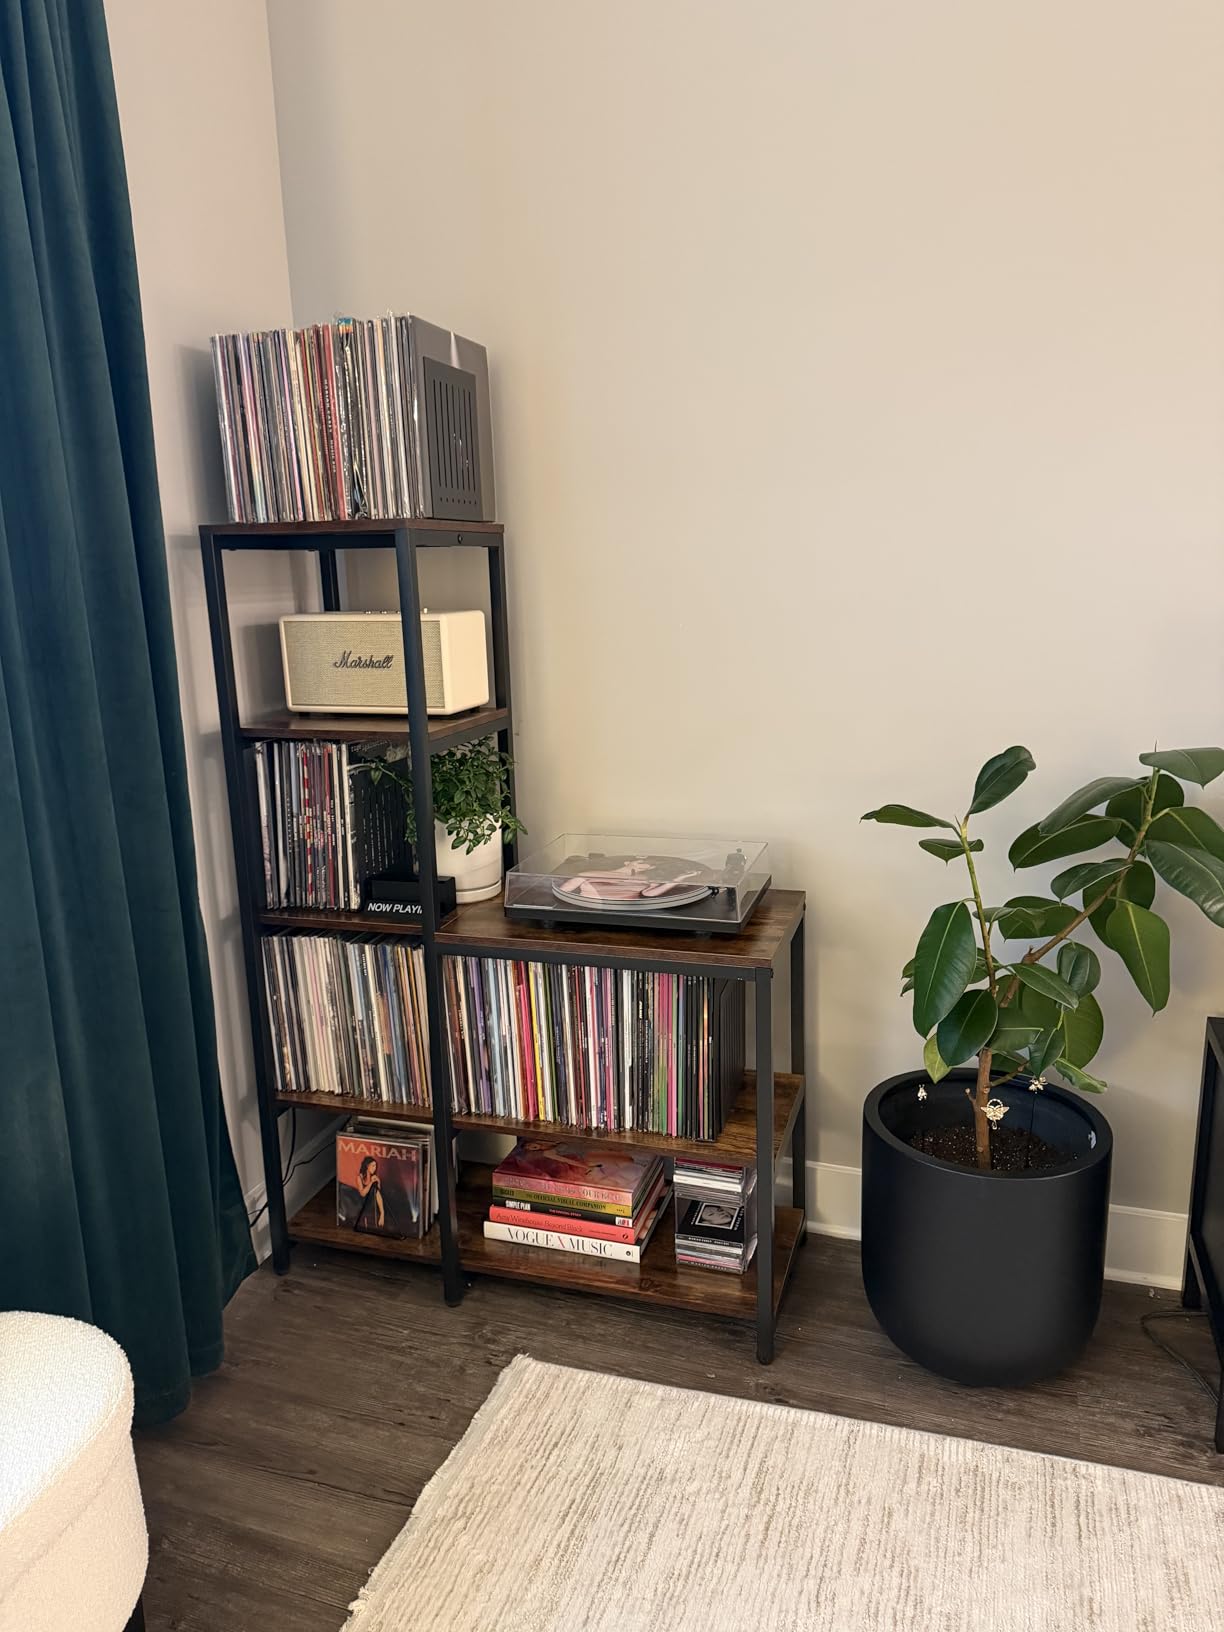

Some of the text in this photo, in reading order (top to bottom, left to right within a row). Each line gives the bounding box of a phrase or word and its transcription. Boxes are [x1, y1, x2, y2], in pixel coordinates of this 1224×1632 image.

[333, 649, 394, 669] Marshall
[367, 902, 422, 914] NOW PLAYI
[339, 1140, 417, 1161] MARIAH
[505, 1199, 531, 1211] SIMPLE PLAN
[507, 1226, 614, 1257] VOGUE X MUSIC
